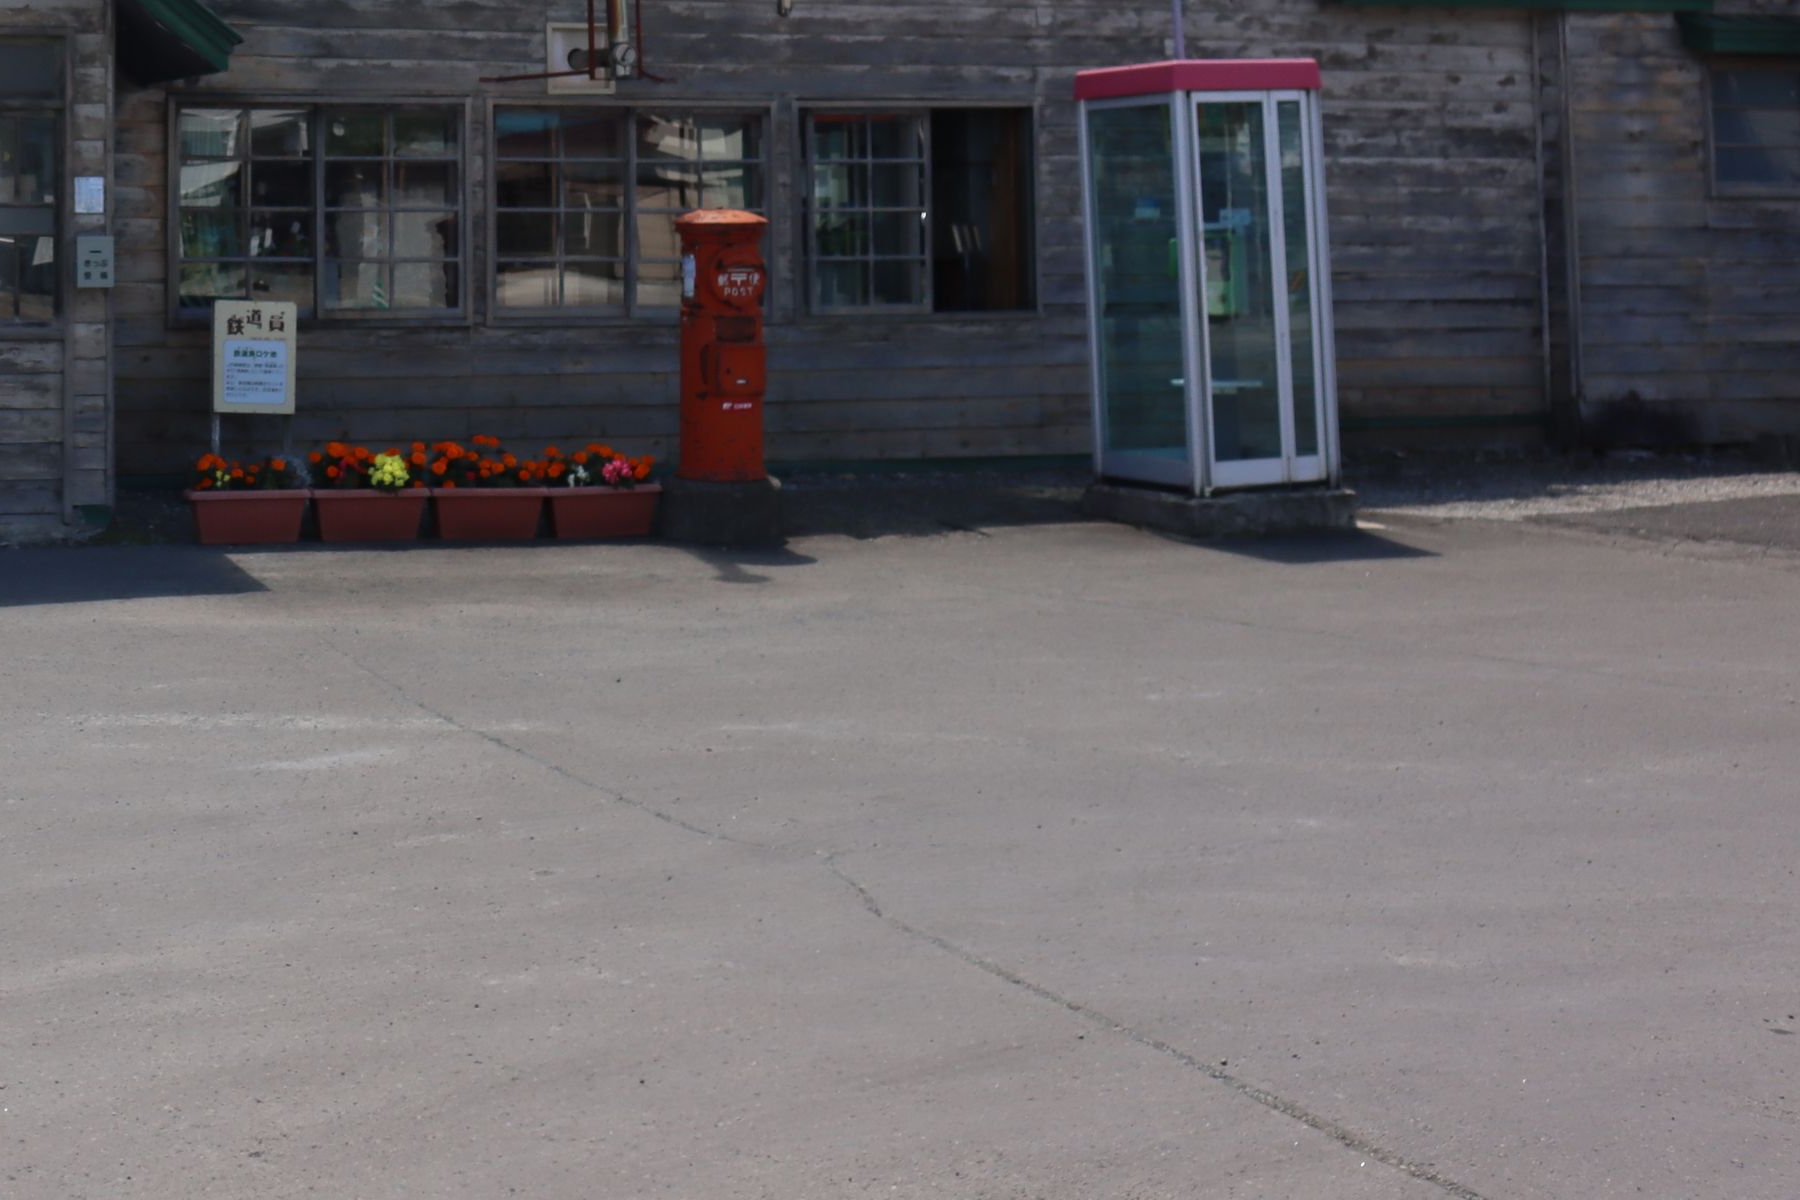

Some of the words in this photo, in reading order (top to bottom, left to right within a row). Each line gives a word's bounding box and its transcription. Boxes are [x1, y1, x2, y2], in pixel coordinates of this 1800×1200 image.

[723, 286, 754, 297] POST
[227, 309, 286, 336] 鉄道員
